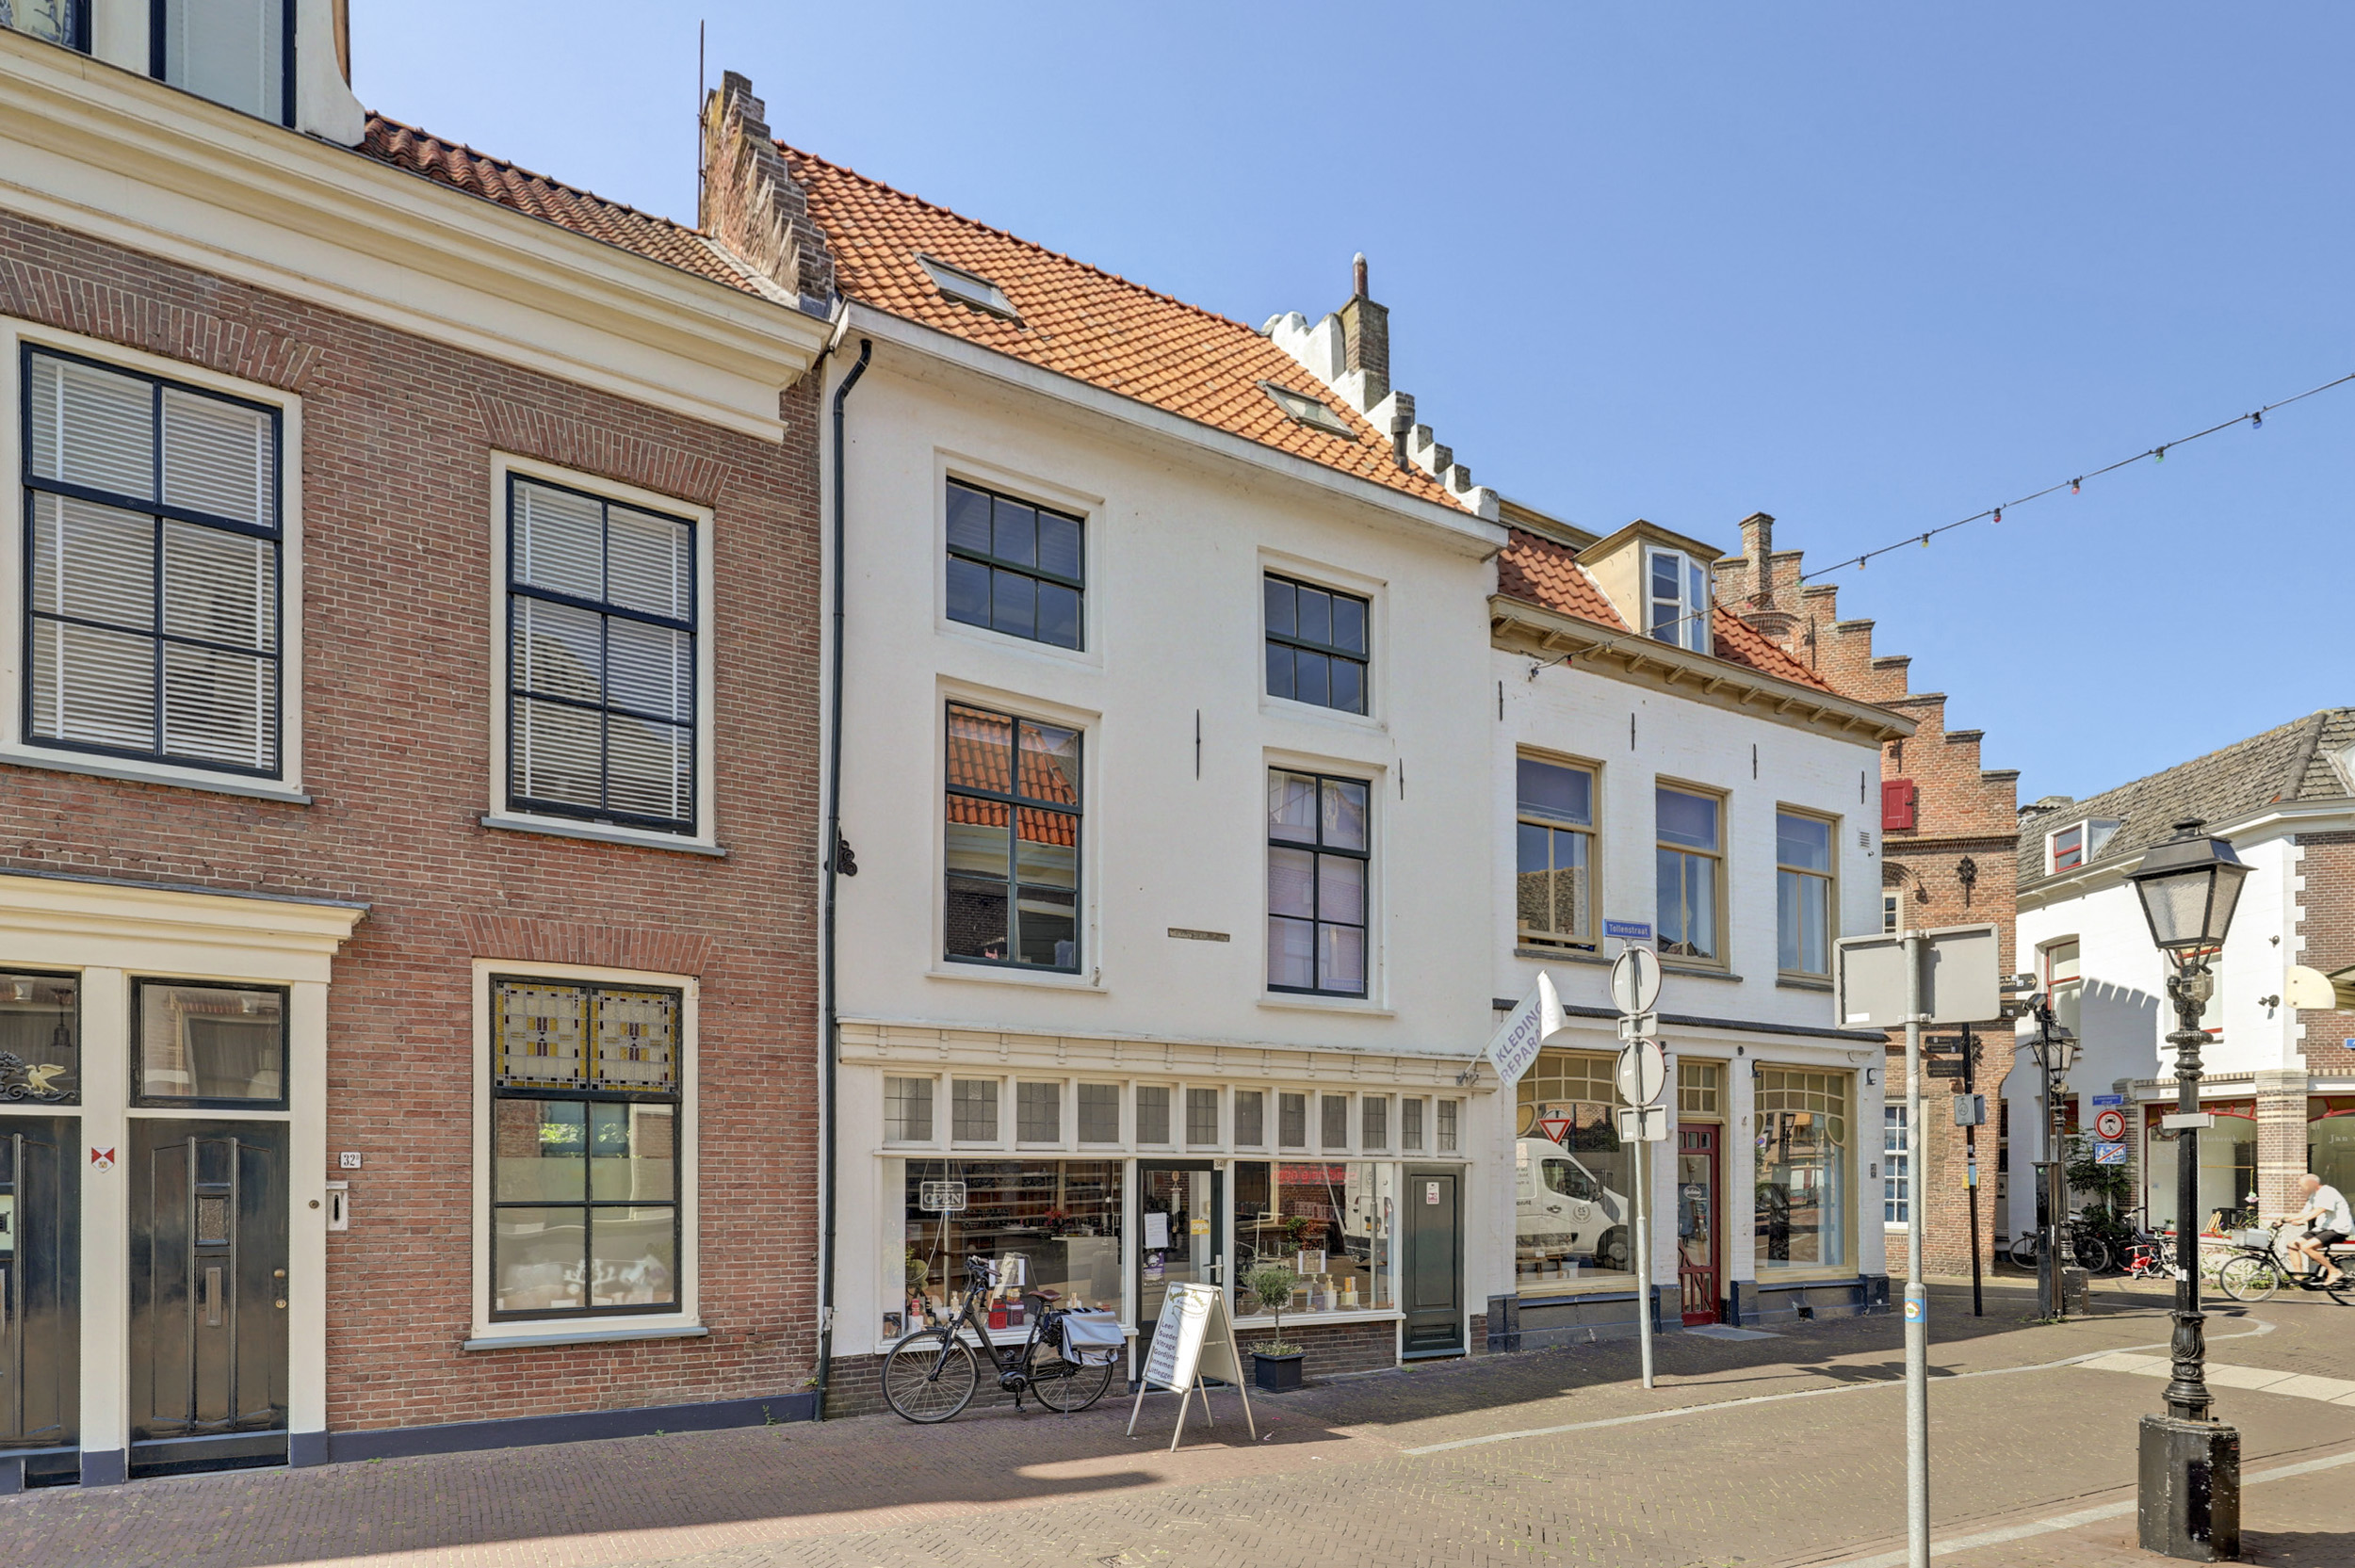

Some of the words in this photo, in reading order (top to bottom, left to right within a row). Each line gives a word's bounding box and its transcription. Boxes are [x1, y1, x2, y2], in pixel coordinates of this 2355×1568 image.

[1609, 924, 1648, 935] Tollenstraat
[2329, 1134, 2347, 1144] Jan
[924, 1192, 962, 1204] OPEN
[1161, 1321, 1174, 1331] Leer
[1157, 1339, 1176, 1350] Vitrage
[1154, 1348, 1179, 1362] Gordijnen
[1151, 1357, 1175, 1370] Innemen
